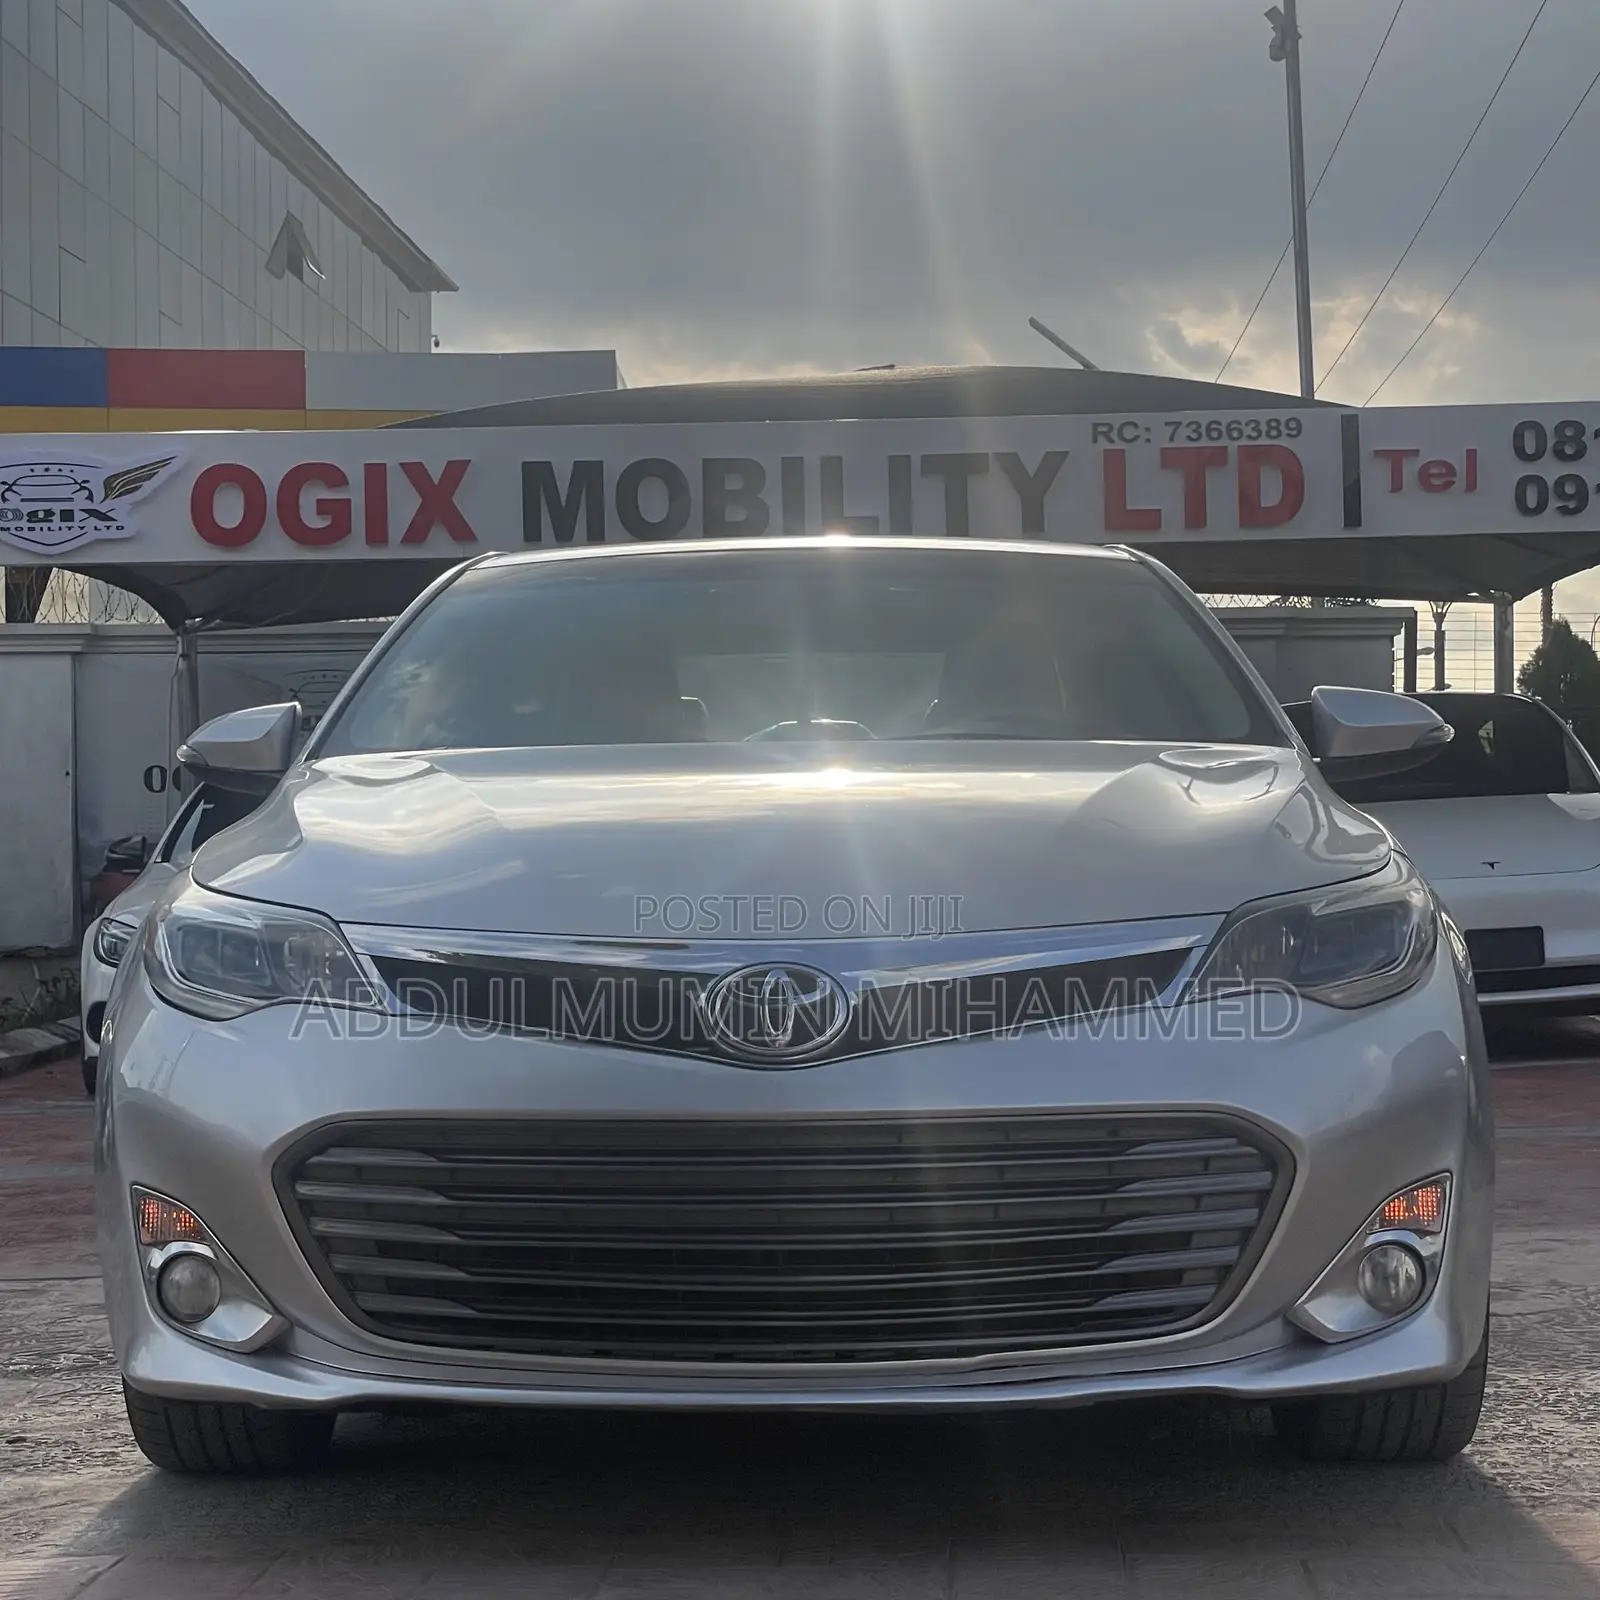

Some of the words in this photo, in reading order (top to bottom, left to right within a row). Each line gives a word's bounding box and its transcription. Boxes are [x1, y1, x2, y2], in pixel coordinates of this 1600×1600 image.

[1091, 421, 1152, 444] RC:
[1164, 417, 1303, 442] 7366389
[1373, 448, 1479, 493] Tel
[190, 459, 479, 548] OGIX
[521, 450, 1070, 543] MOBILITY
[1103, 444, 1306, 531] LTD
